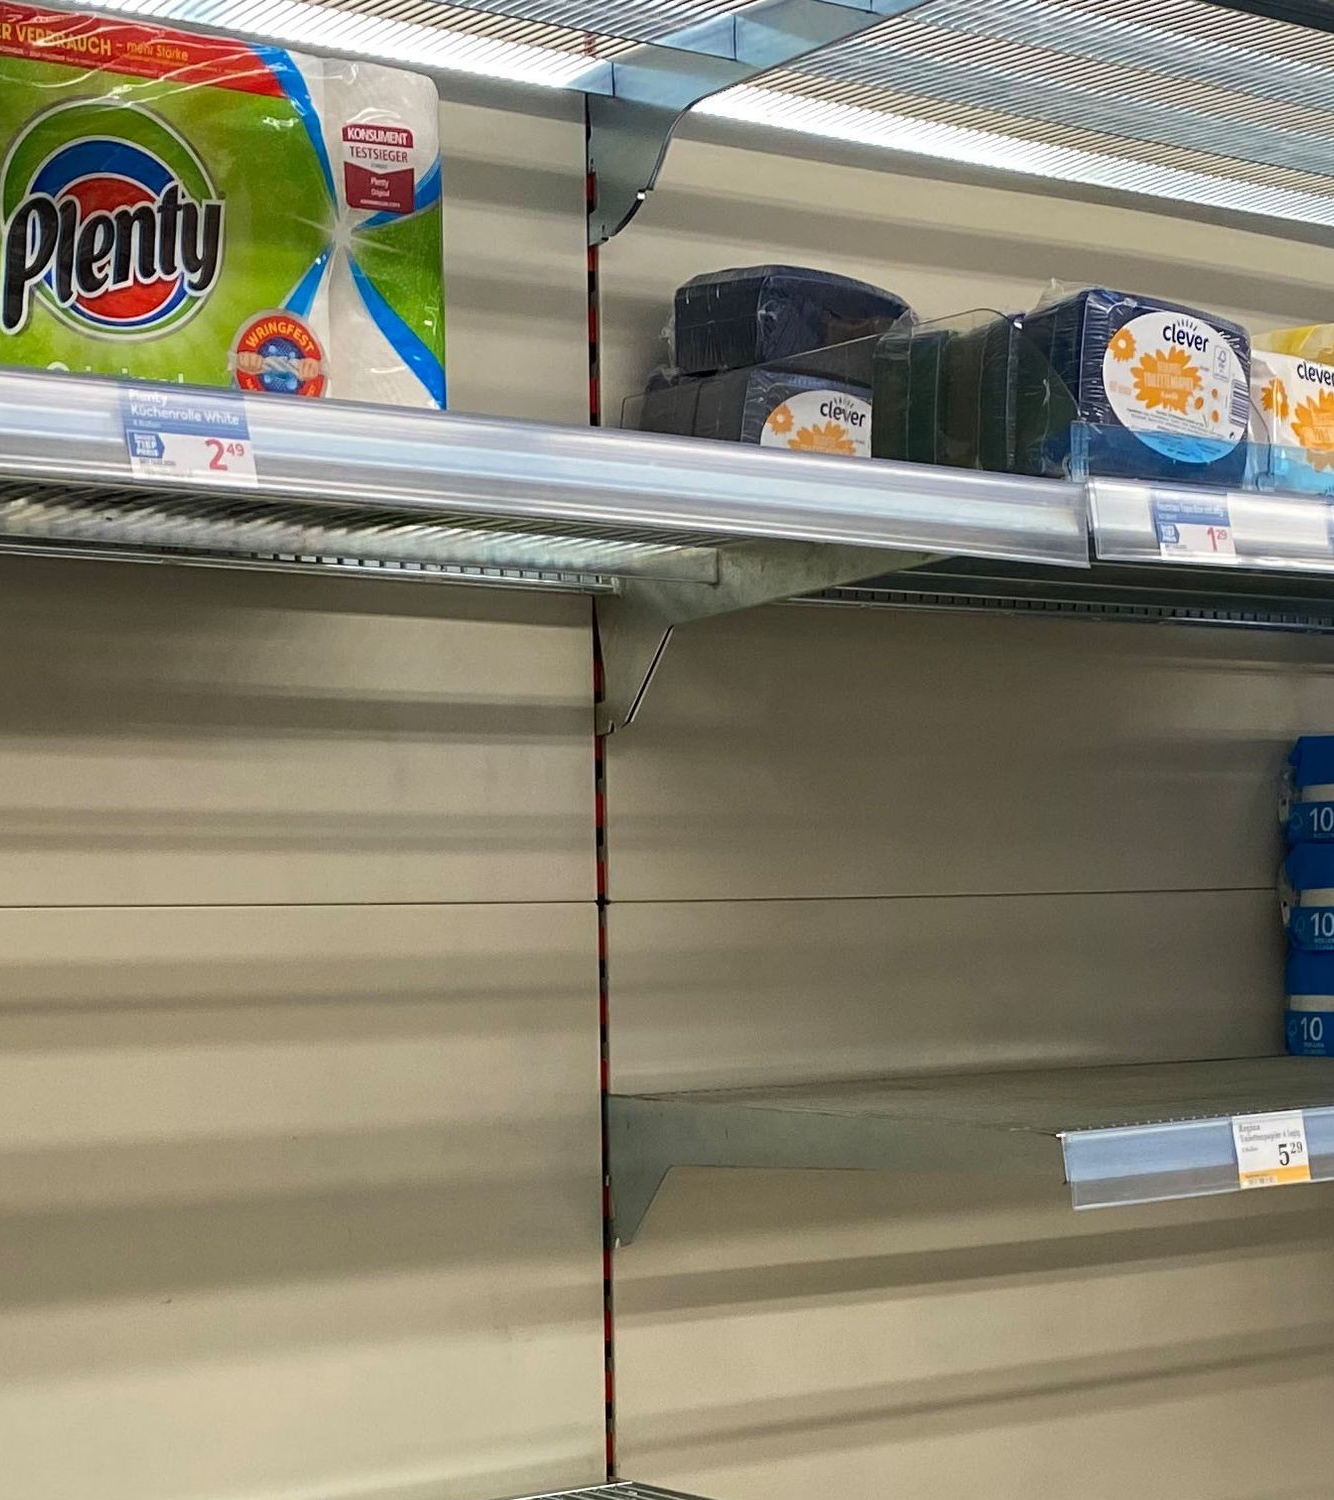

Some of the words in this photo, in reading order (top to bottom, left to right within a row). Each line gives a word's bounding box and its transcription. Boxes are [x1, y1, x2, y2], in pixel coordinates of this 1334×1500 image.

[347, 127, 408, 146] KONSUMENT
[349, 145, 409, 163] TESTSIEGER
[3, 184, 223, 332] Plenty
[245, 321, 315, 352] WRINGFEST
[1162, 324, 1210, 352] clever
[130, 405, 202, 424] Küchenrolle
[204, 407, 240, 426] White
[820, 400, 866, 428] clever
[1309, 807, 1334, 832] 10
[1300, 1016, 1323, 1041] 10
